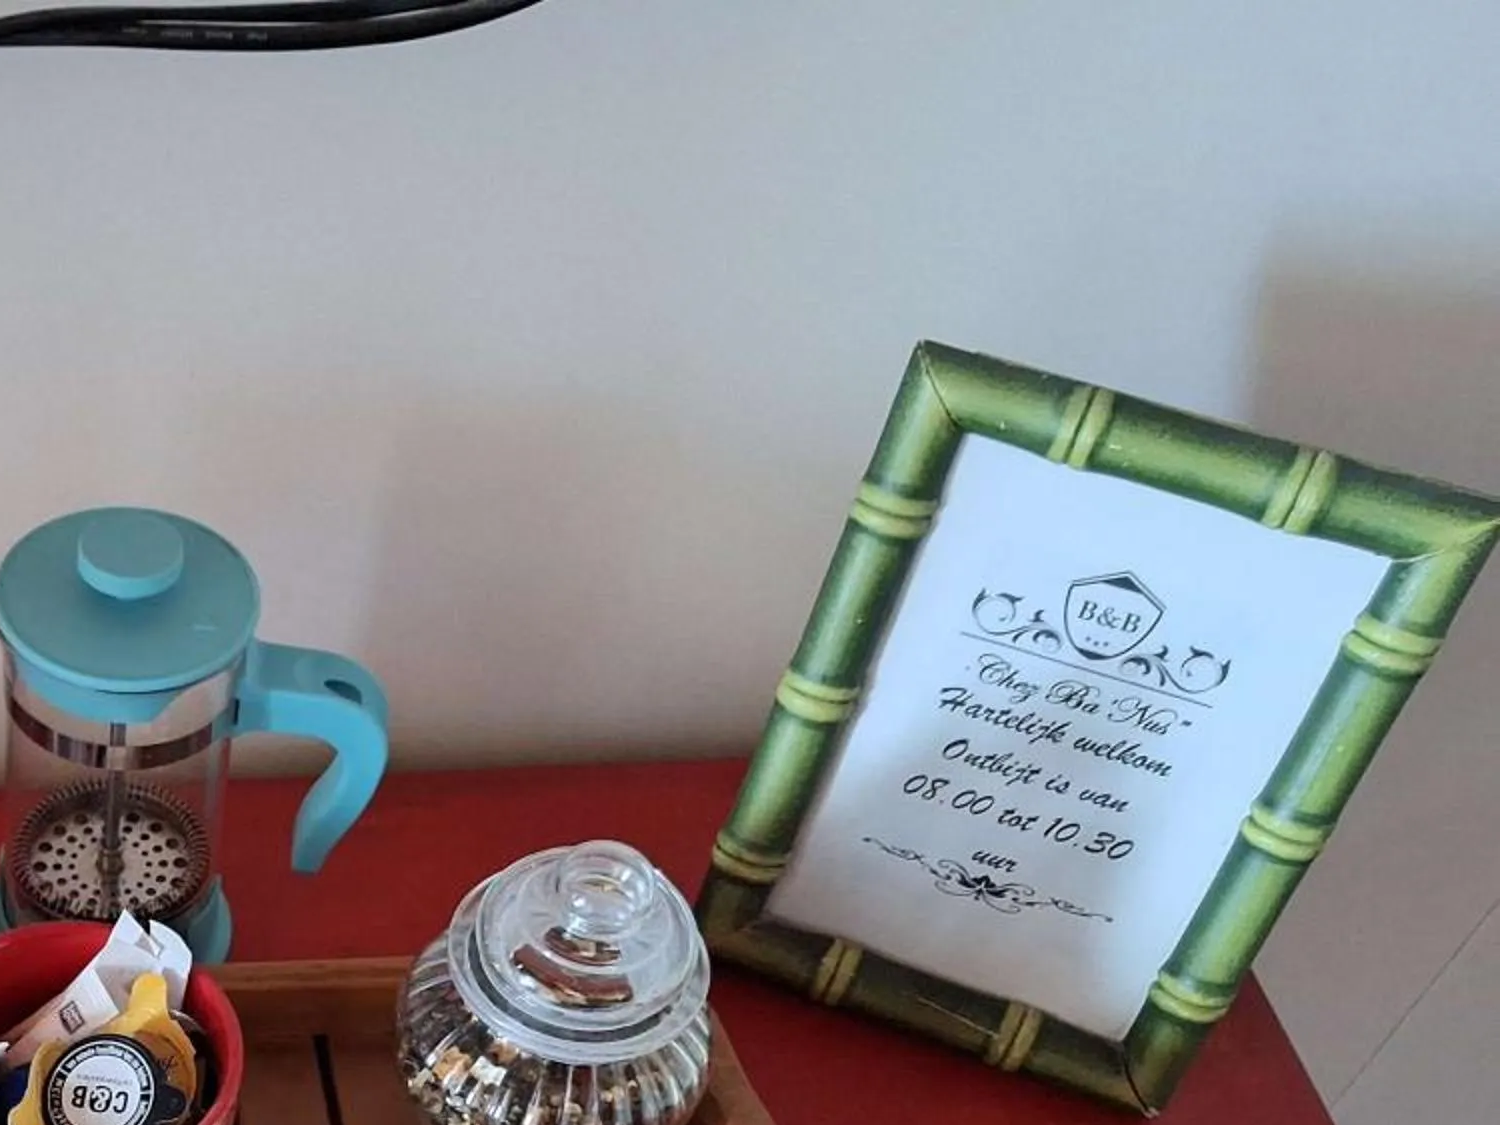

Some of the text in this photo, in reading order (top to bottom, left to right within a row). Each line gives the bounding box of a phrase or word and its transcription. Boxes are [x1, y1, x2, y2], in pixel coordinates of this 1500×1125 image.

[1078, 599, 1142, 634] B&B
[978, 653, 1040, 704] Chez
[938, 686, 1173, 777] Hartelijk welkom
[942, 738, 1130, 813] Ontbijt is van
[903, 774, 1135, 860] 08.00 tot 10.30
[971, 850, 1018, 873] uur
